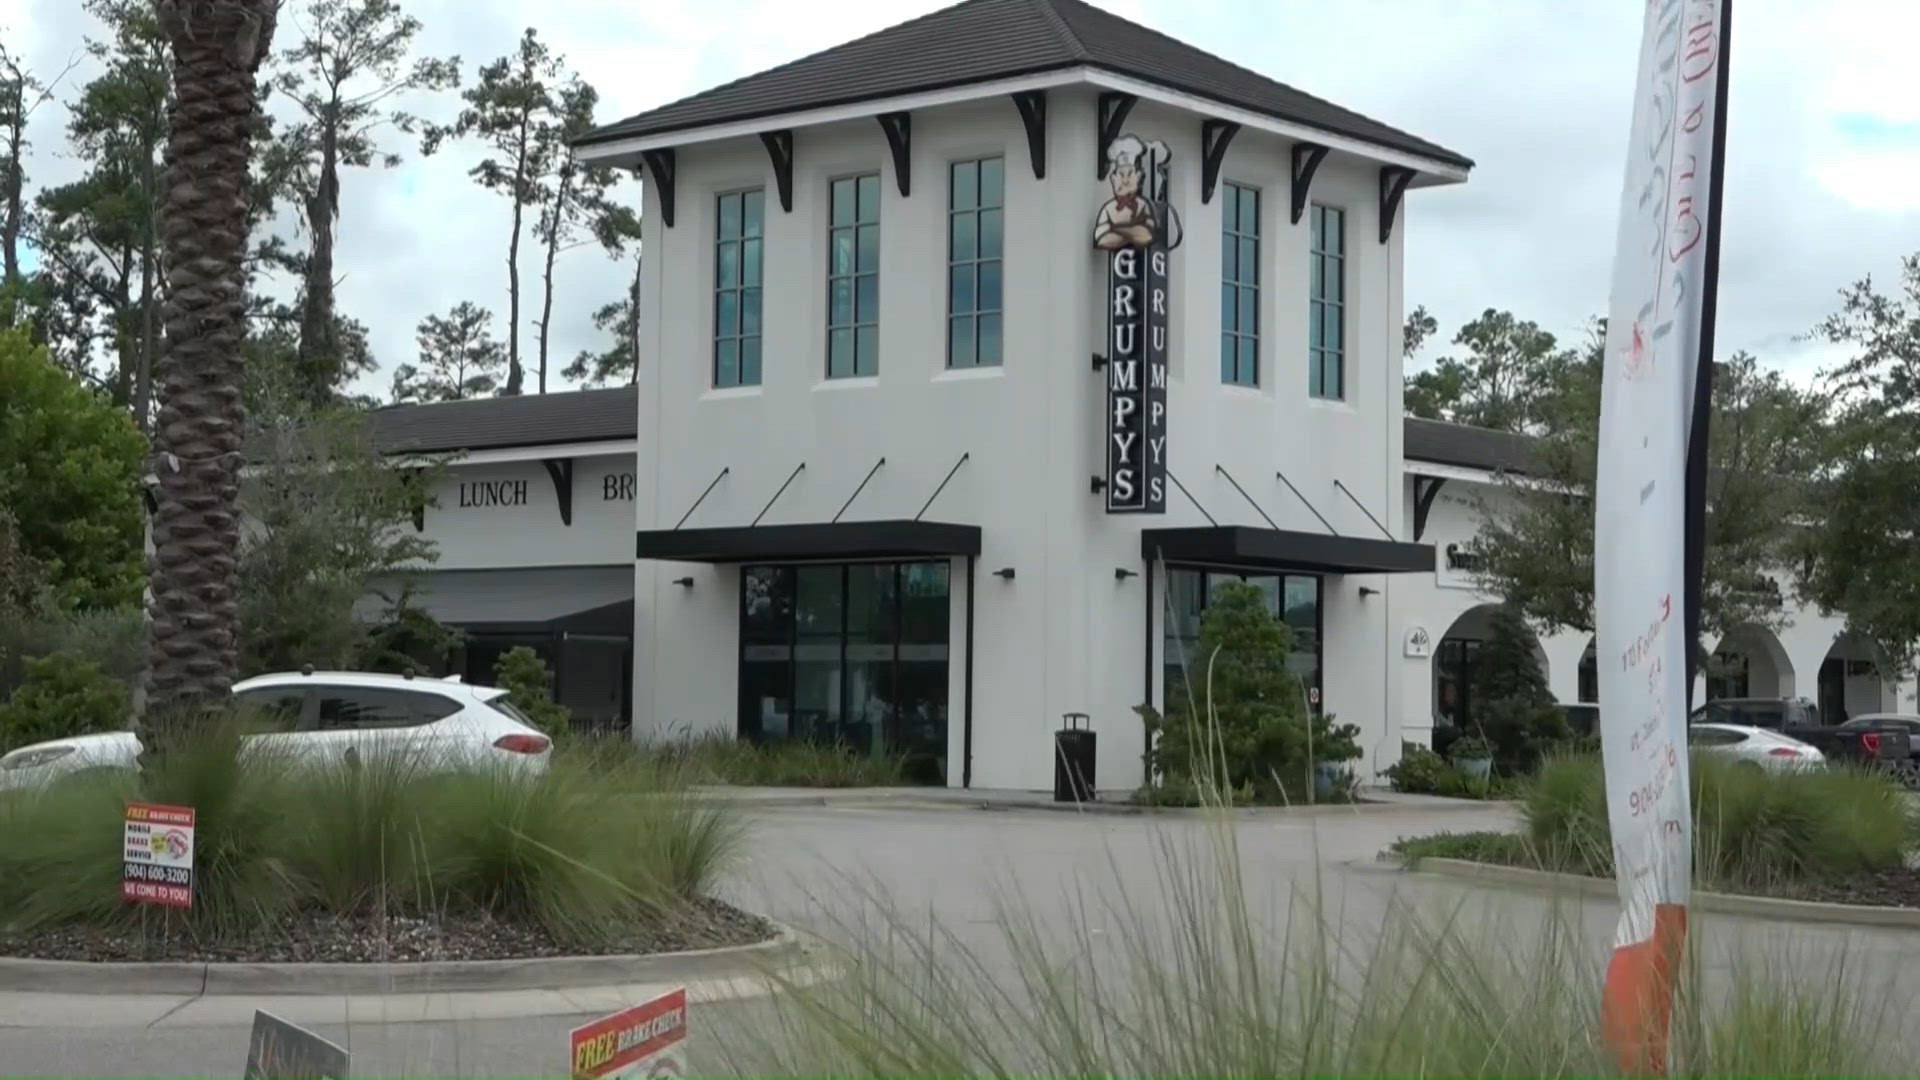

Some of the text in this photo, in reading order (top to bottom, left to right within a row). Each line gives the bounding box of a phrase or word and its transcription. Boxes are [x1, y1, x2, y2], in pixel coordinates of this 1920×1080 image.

[1112, 247, 1138, 501] GRUMPYS
[1149, 250, 1166, 503] GRUMPYS
[459, 480, 528, 507] LUNCH
[127, 807, 150, 820] FREE
[124, 863, 189, 884] (904) 600-3200
[124, 882, 135, 895] WE
[136, 884, 156, 898] COME
[157, 886, 168, 899] TO
[576, 1006, 682, 1073] FREE BRAKE CHECK
